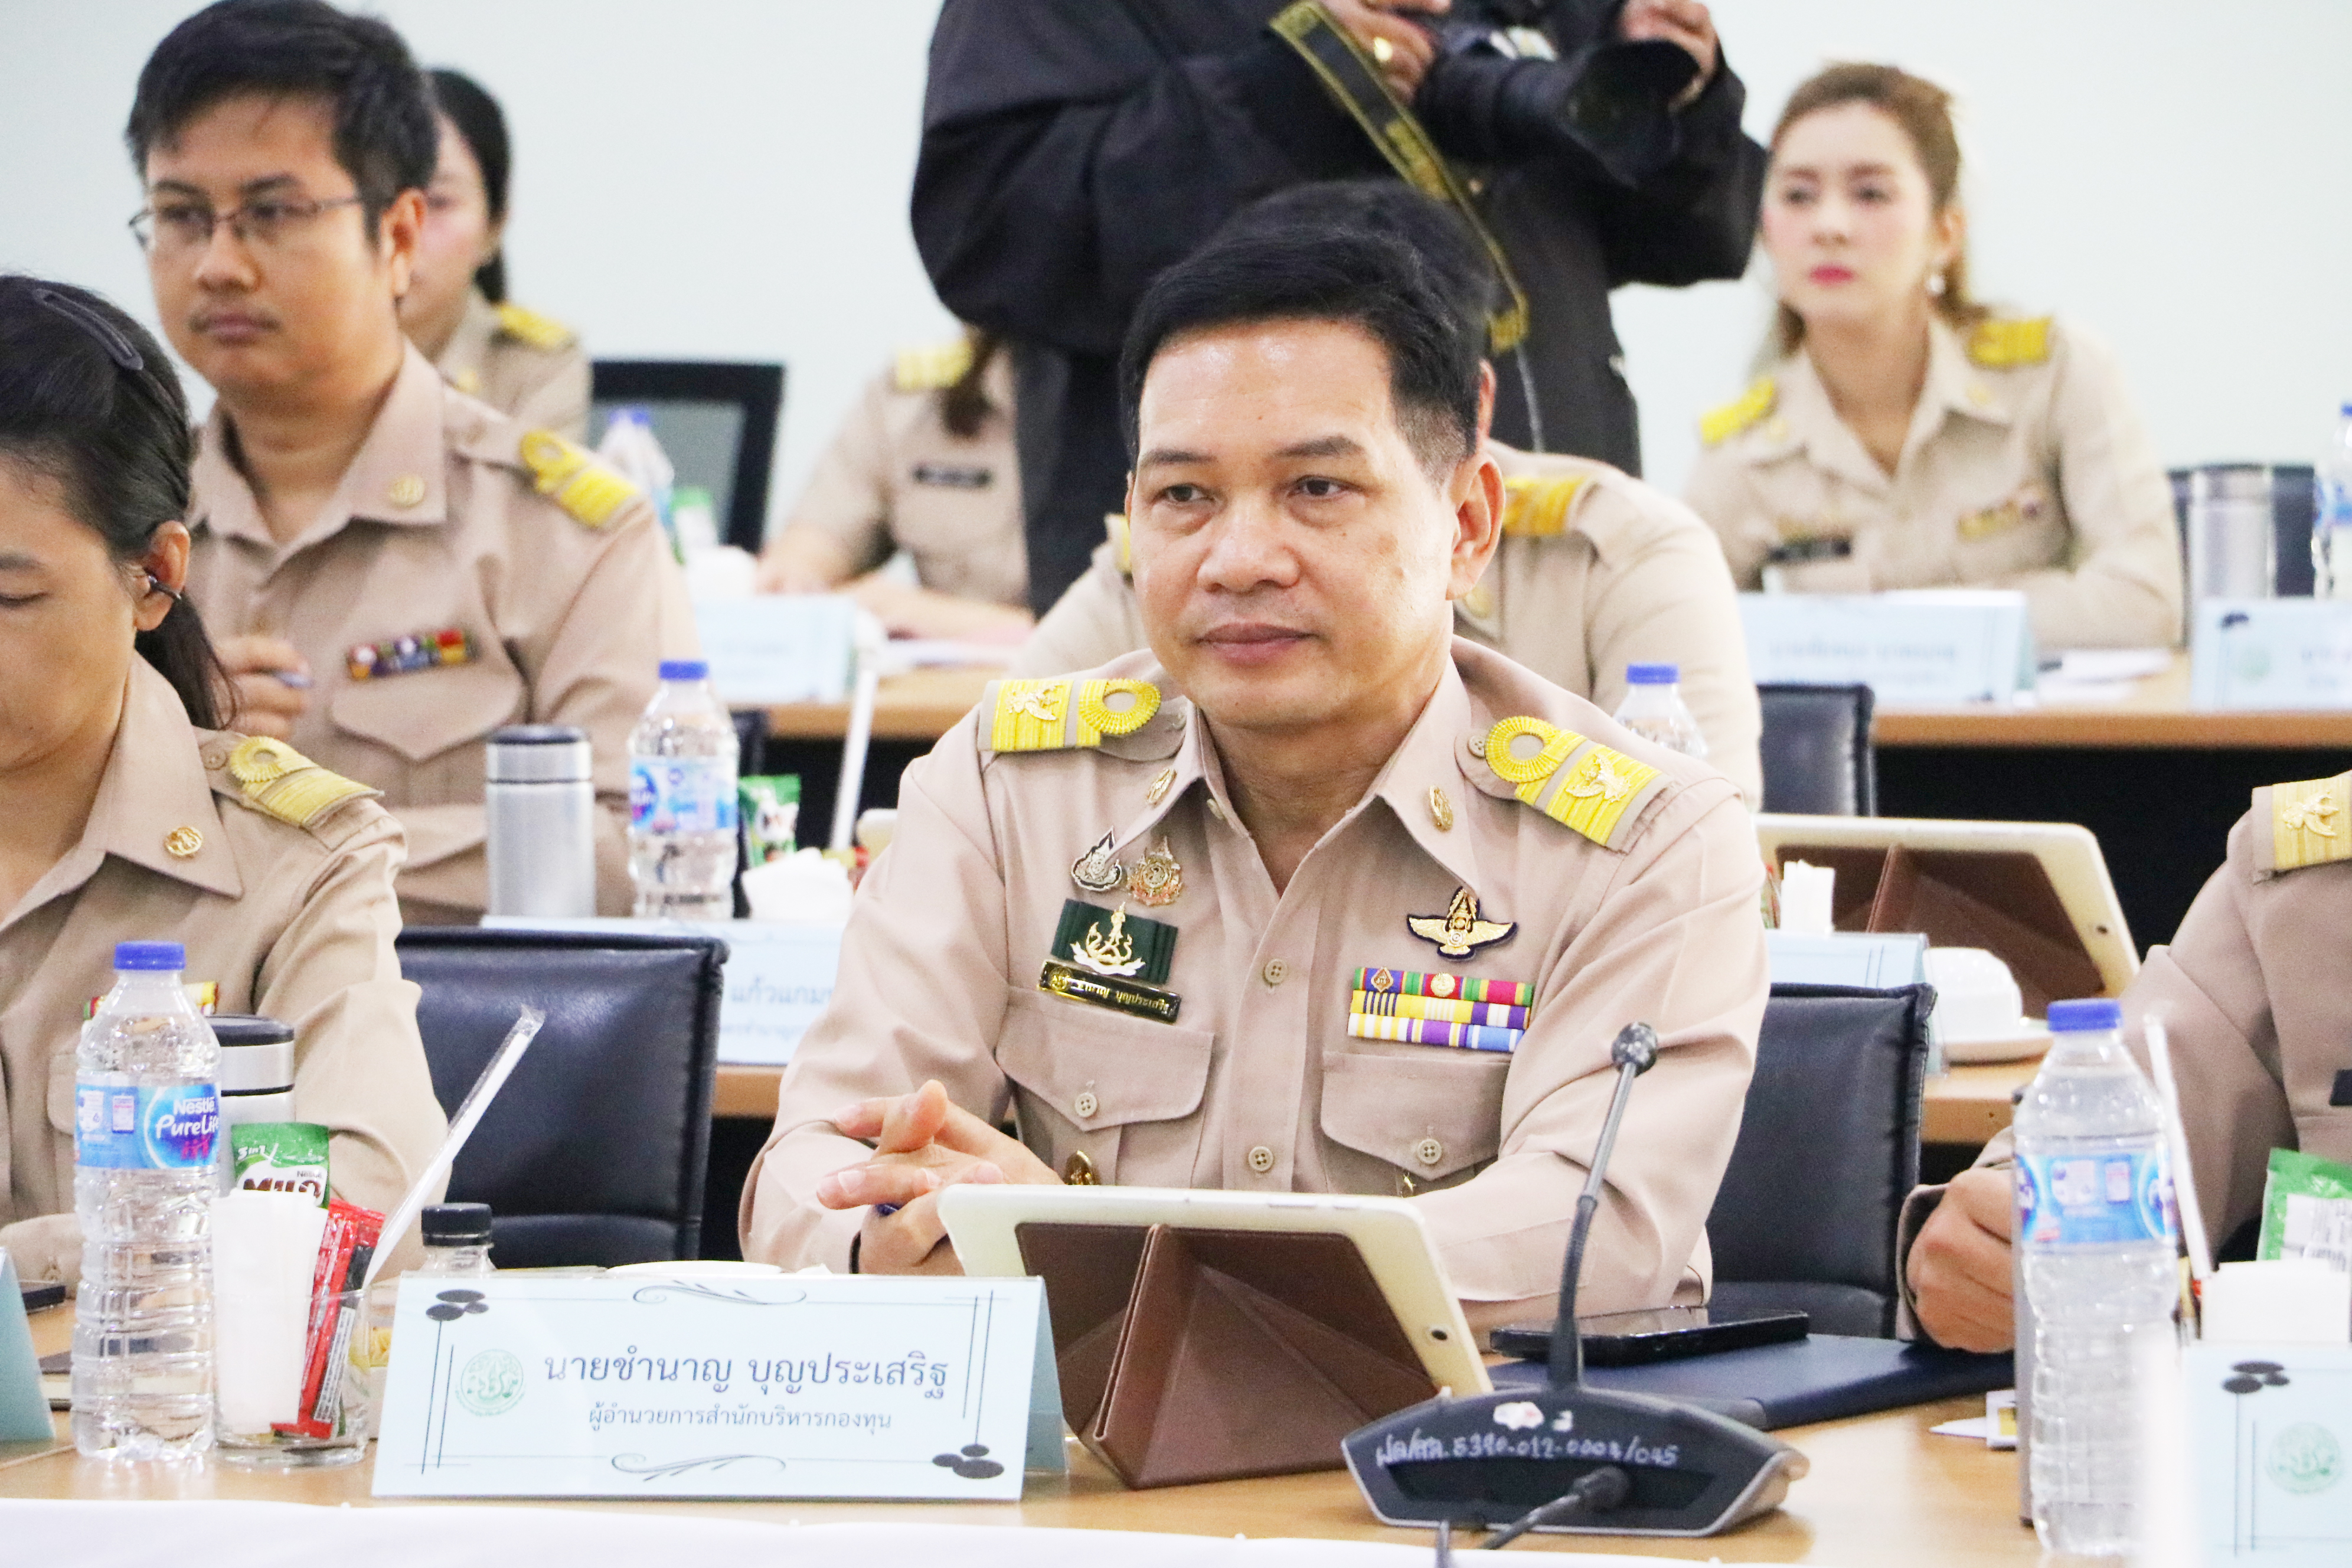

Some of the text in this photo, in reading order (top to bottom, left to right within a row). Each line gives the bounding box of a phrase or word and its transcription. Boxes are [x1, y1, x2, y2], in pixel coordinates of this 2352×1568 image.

[544, 1345, 949, 1400] นายชำนาญ บุญประเสริฐ
[589, 1400, 891, 1435] ผู้อำนวยการสำนักบริหารกองทุน
